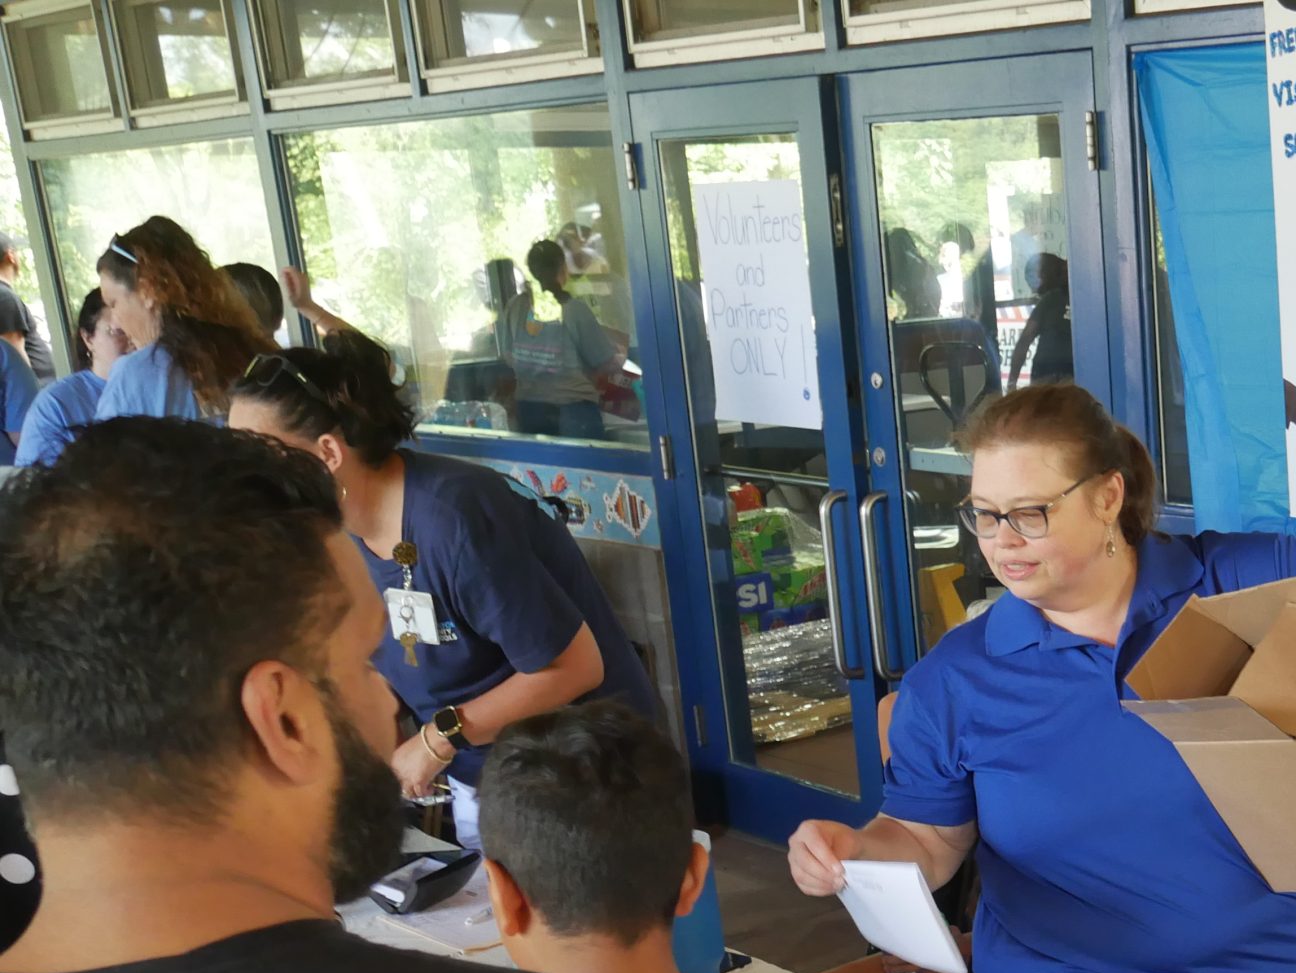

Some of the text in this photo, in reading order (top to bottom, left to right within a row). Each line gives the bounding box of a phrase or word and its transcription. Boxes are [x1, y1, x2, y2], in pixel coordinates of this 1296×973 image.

[703, 191, 801, 246] Volunteers
[736, 252, 766, 287] and
[710, 288, 789, 333] Partners
